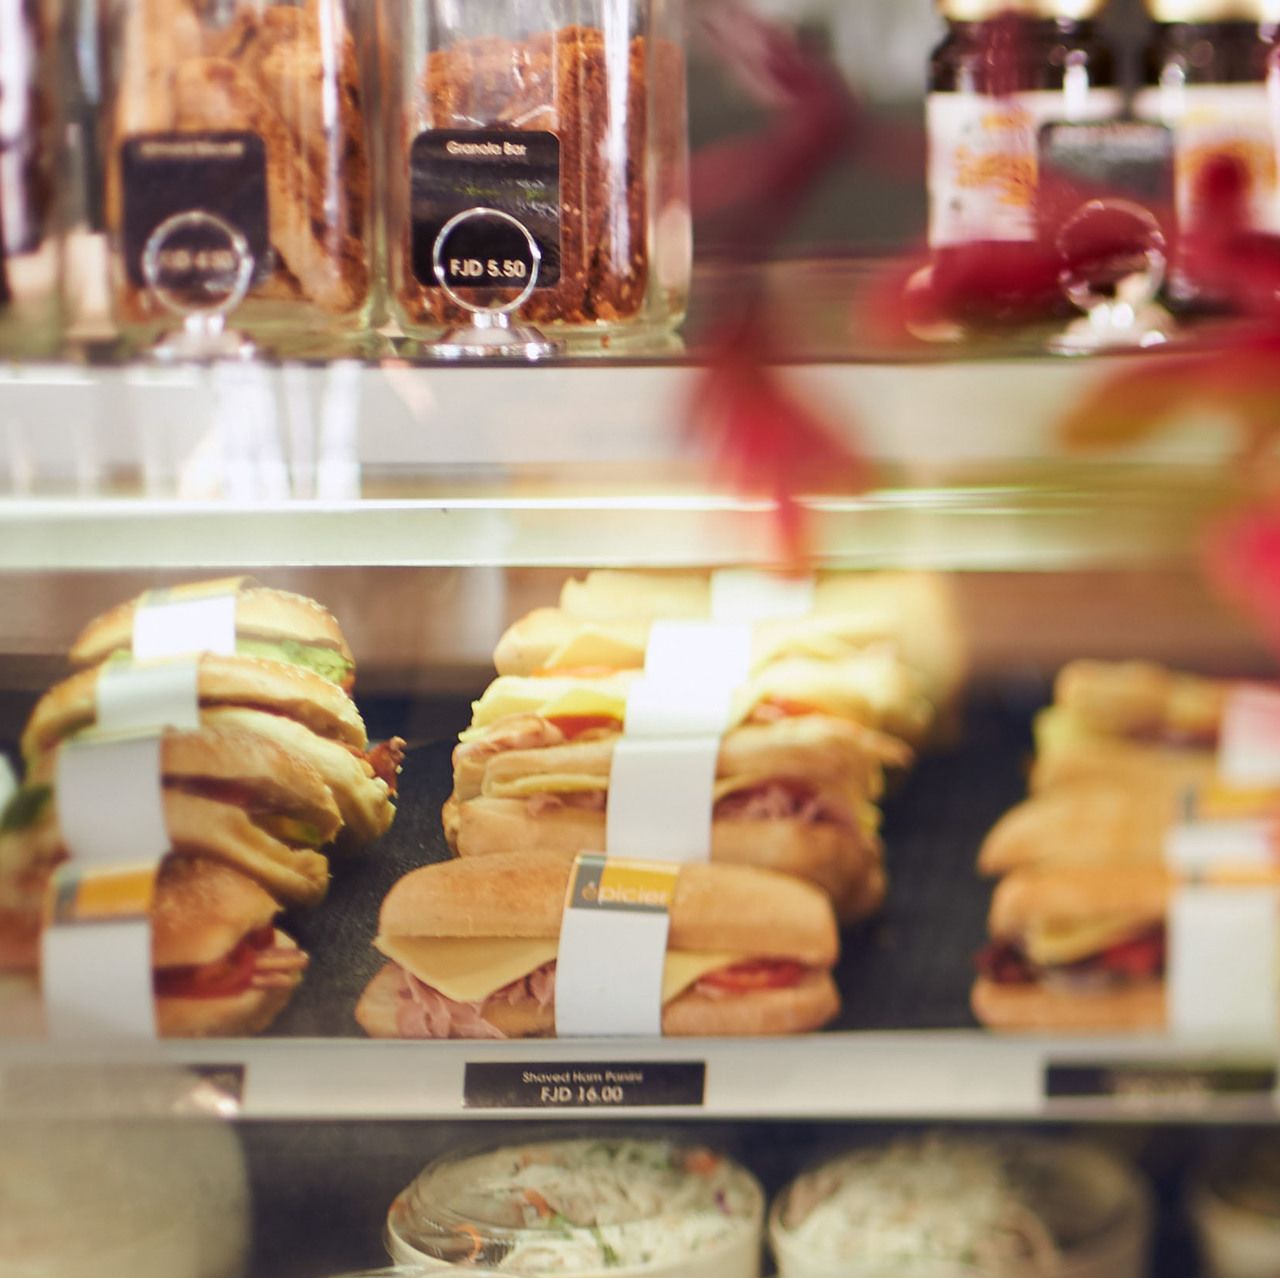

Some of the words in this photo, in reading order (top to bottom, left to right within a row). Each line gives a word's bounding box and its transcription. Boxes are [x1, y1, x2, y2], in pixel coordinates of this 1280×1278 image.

[446, 140, 502, 156] Granola
[503, 140, 528, 156] Bar
[450, 258, 484, 278] FJD
[486, 258, 527, 279] 5.50
[522, 1071, 570, 1084] Shaved
[572, 1071, 603, 1084] Ham
[605, 1071, 643, 1084] Panini
[540, 1086, 572, 1102] FJD
[578, 1086, 624, 1102] 16.00
